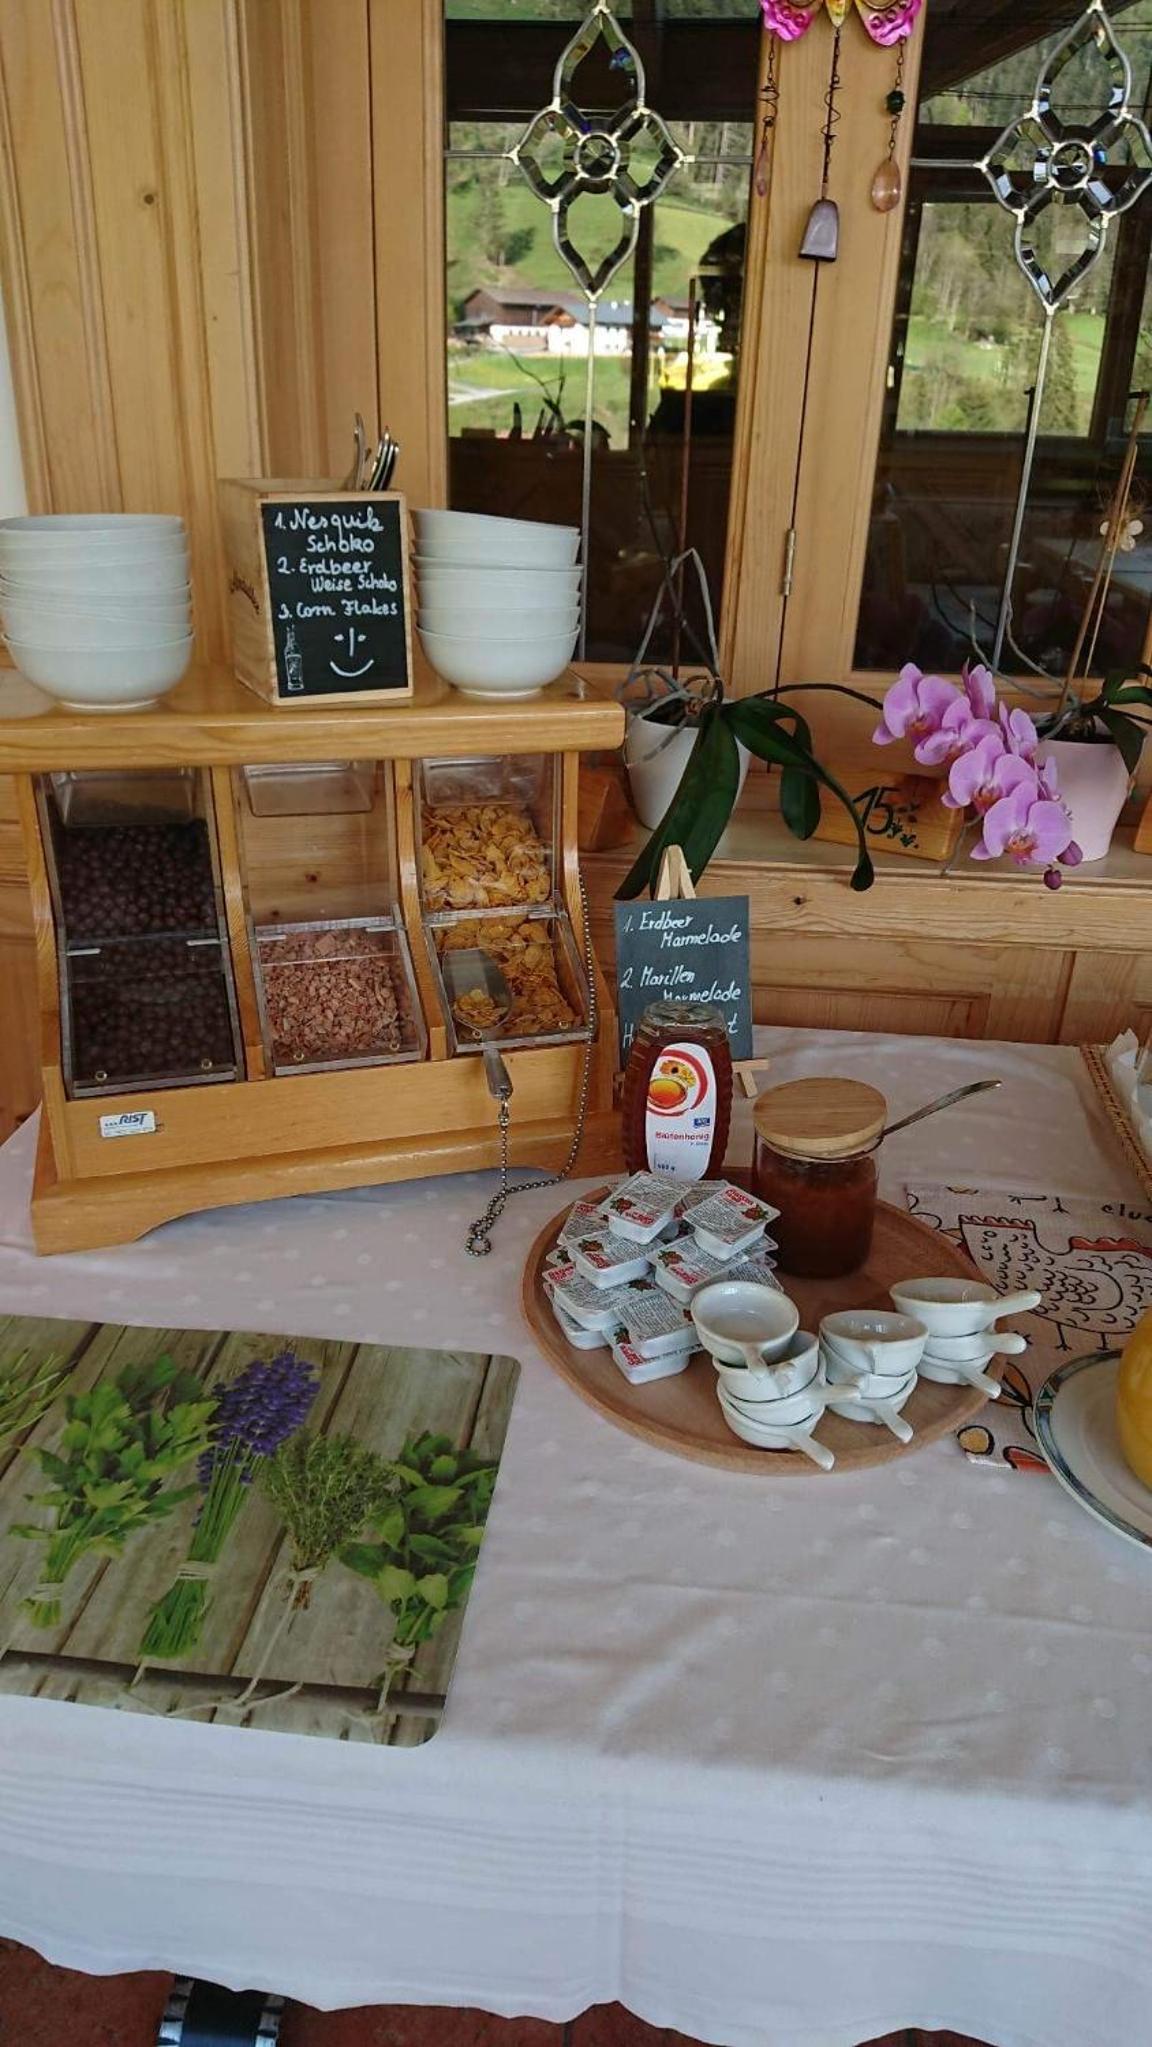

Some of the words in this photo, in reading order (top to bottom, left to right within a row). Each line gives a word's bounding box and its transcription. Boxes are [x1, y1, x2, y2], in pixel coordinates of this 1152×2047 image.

[275, 512, 287, 530] 1.
[290, 506, 384, 536] Nesquik
[306, 534, 374, 554] Schoko
[277, 556, 296, 574] 2.
[299, 557, 373, 575] Erdbeer
[311, 577, 353, 593] Weise
[358, 572, 398, 592] Schoko
[278, 603, 293, 620] 3.
[296, 602, 335, 619] Corn
[341, 598, 398, 616] Flakes
[623, 914, 634, 933] 1.
[638, 910, 694, 931] Erdbeer
[660, 924, 742, 949] Marmelade
[640, 964, 696, 988] Marillen
